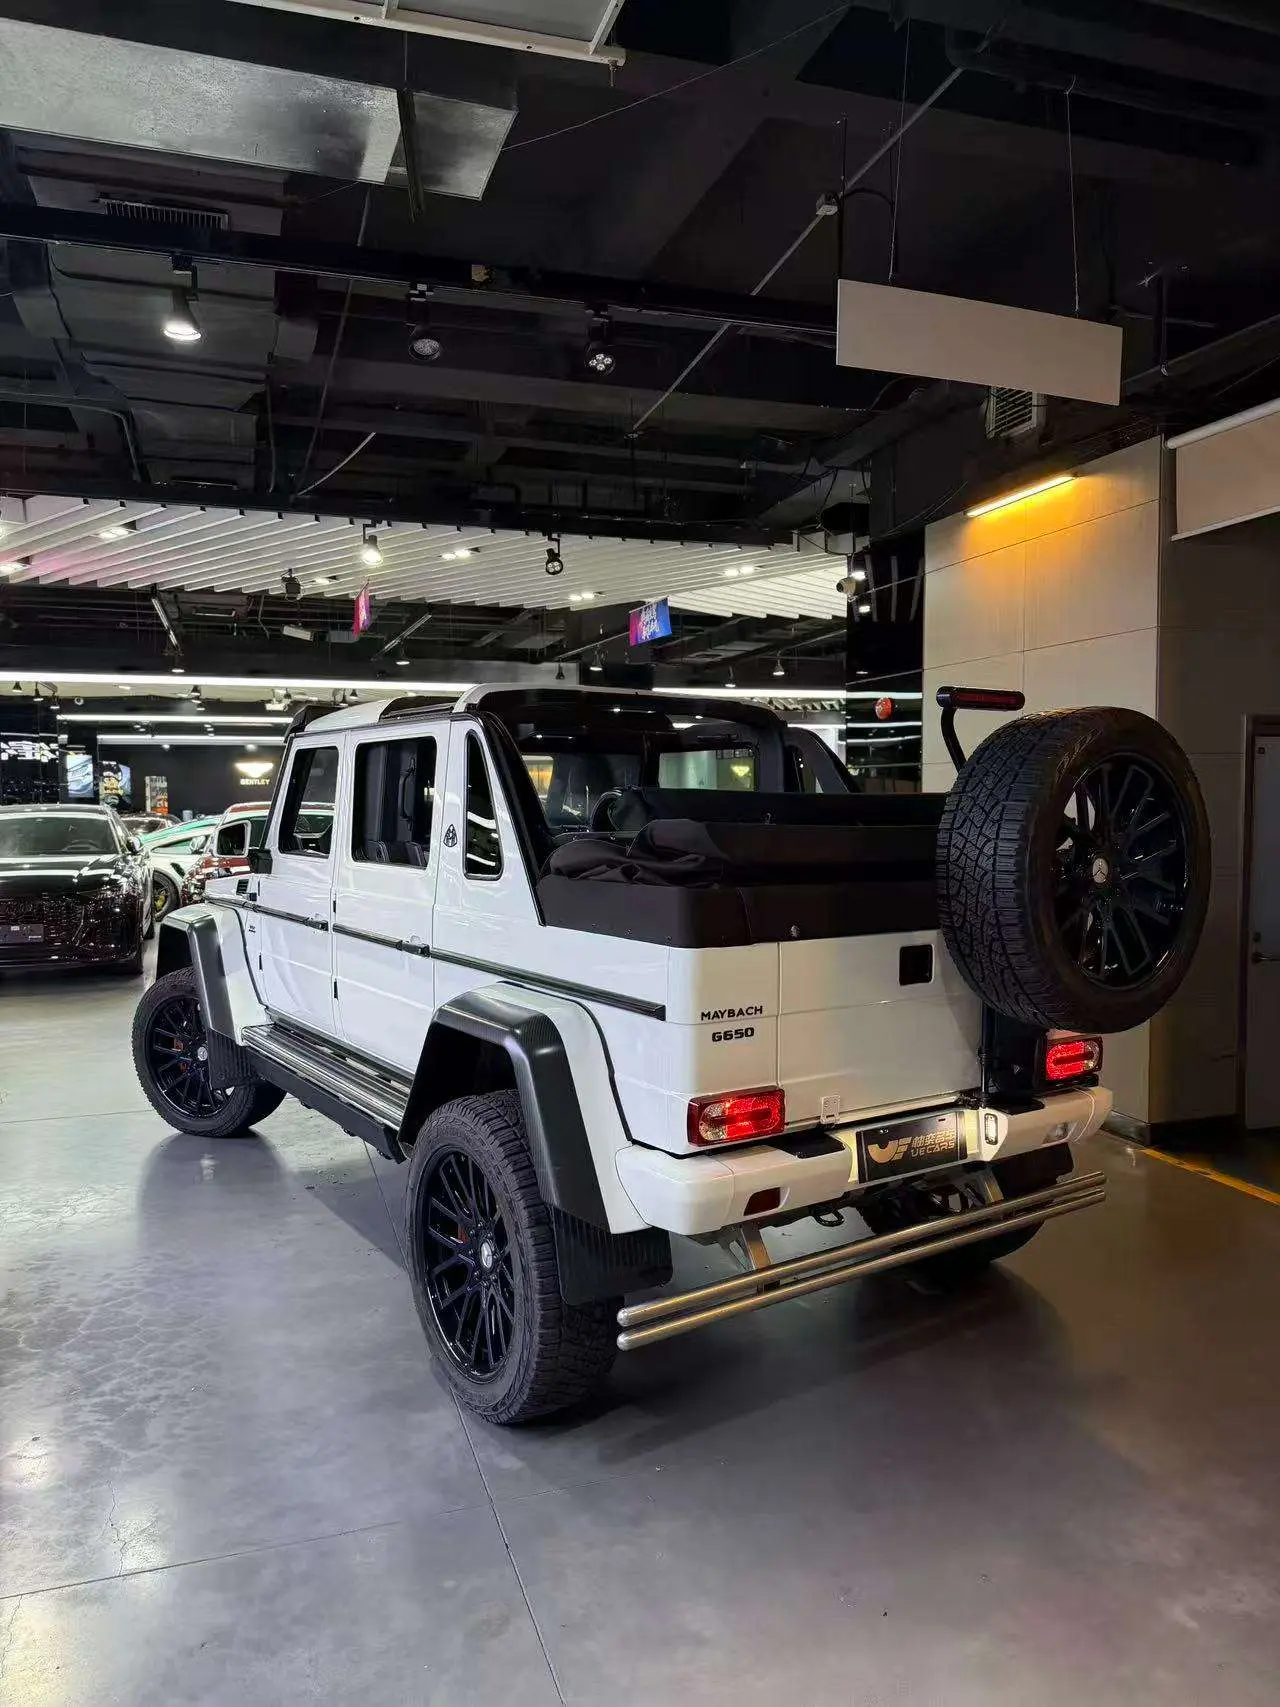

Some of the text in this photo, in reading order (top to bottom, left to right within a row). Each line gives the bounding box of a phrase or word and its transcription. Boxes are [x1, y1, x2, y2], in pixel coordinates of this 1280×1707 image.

[240, 778, 271, 786] BENTLEY
[701, 1005, 763, 1021] MAYBACH
[711, 1027, 755, 1042] G650
